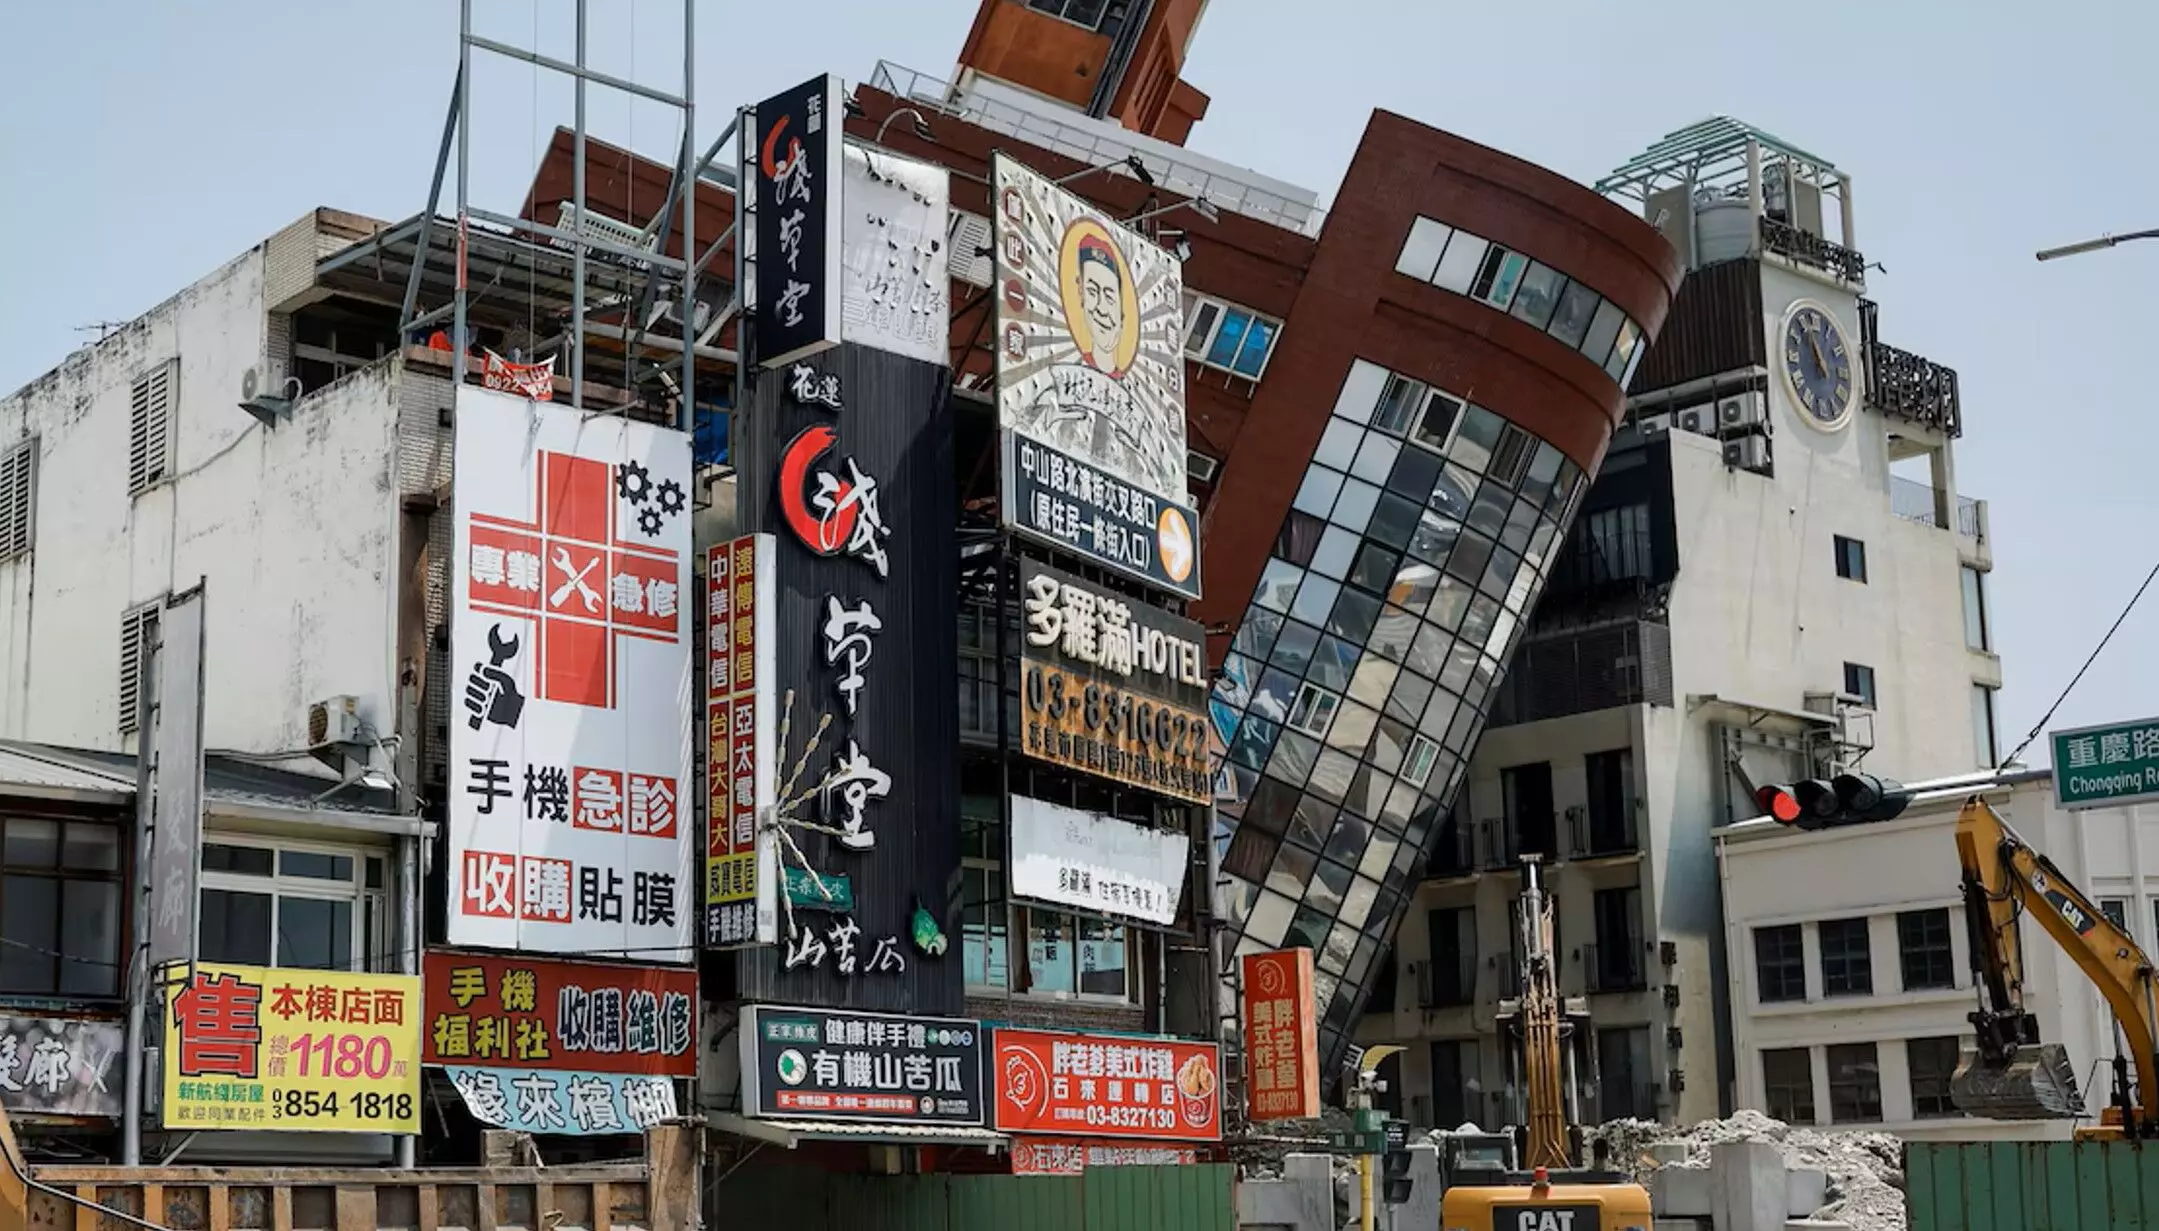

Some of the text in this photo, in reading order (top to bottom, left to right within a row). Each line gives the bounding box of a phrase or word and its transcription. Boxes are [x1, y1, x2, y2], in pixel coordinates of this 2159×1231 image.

[792, 363, 843, 410] 花蓮
[471, 544, 678, 617] 專業 急修
[711, 554, 728, 690] 中華電信
[735, 547, 753, 683] 遠傳電信
[1025, 573, 1208, 689] 多羅滿 HOTEL
[1027, 665, 1207, 762] 03-8316622
[735, 704, 753, 845] 亞太電信
[2067, 727, 2159, 769] 重慶路
[467, 758, 676, 834] 手機急診
[711, 712, 728, 850] 台灣大哥大
[2069, 771, 2142, 794] Chongqing
[465, 856, 676, 928] 收購貼膜
[2062, 901, 2084, 928] CAT
[270, 984, 405, 1026] 本棟店面
[450, 967, 537, 1013] 手機
[172, 971, 262, 1078] 售
[433, 1013, 552, 1060] 福利社
[558, 985, 692, 1056] 收購維修
[825, 1018, 926, 1049] 健康伴手禮
[290, 1033, 393, 1080] 1180
[812, 1049, 963, 1092] 有機山苦瓜
[1087, 1105, 1175, 1129] 03-8327130
